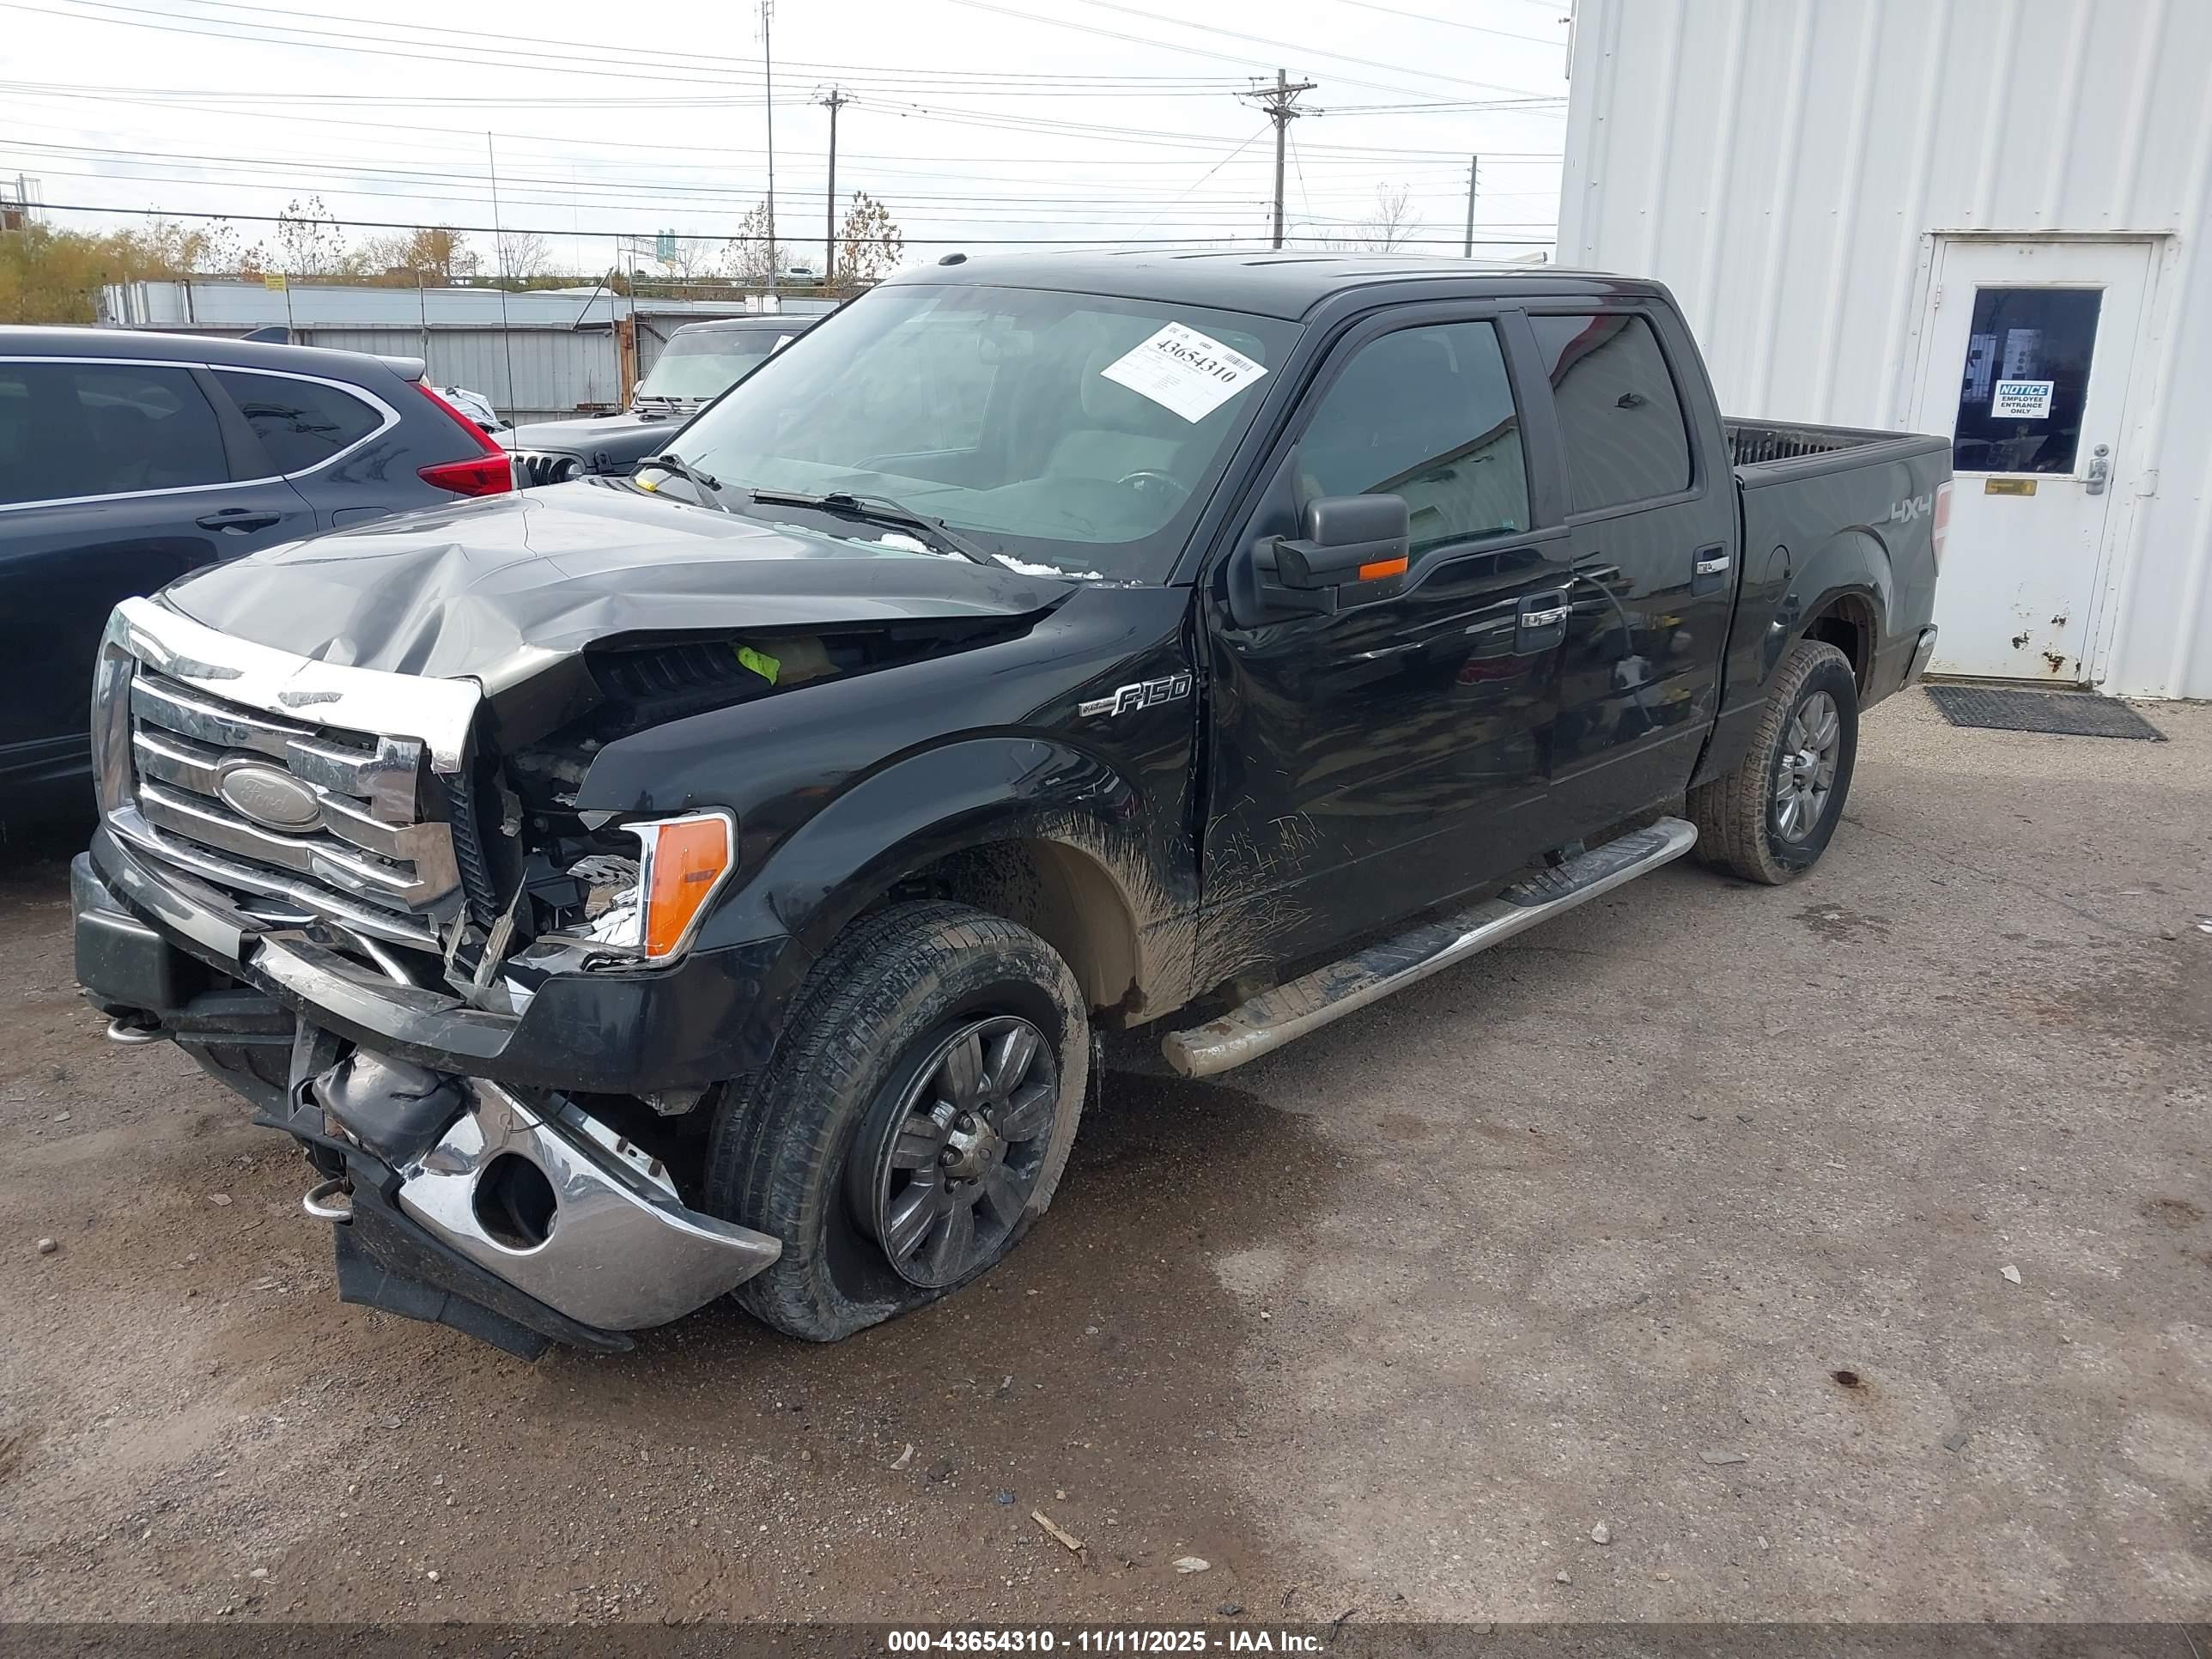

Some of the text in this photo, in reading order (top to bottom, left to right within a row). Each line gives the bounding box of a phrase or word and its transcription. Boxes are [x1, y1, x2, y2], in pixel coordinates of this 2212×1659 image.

[1157, 339, 1237, 383] 43654310
[2000, 385, 2048, 395] NOTICE
[240, 778, 290, 812] Ford
